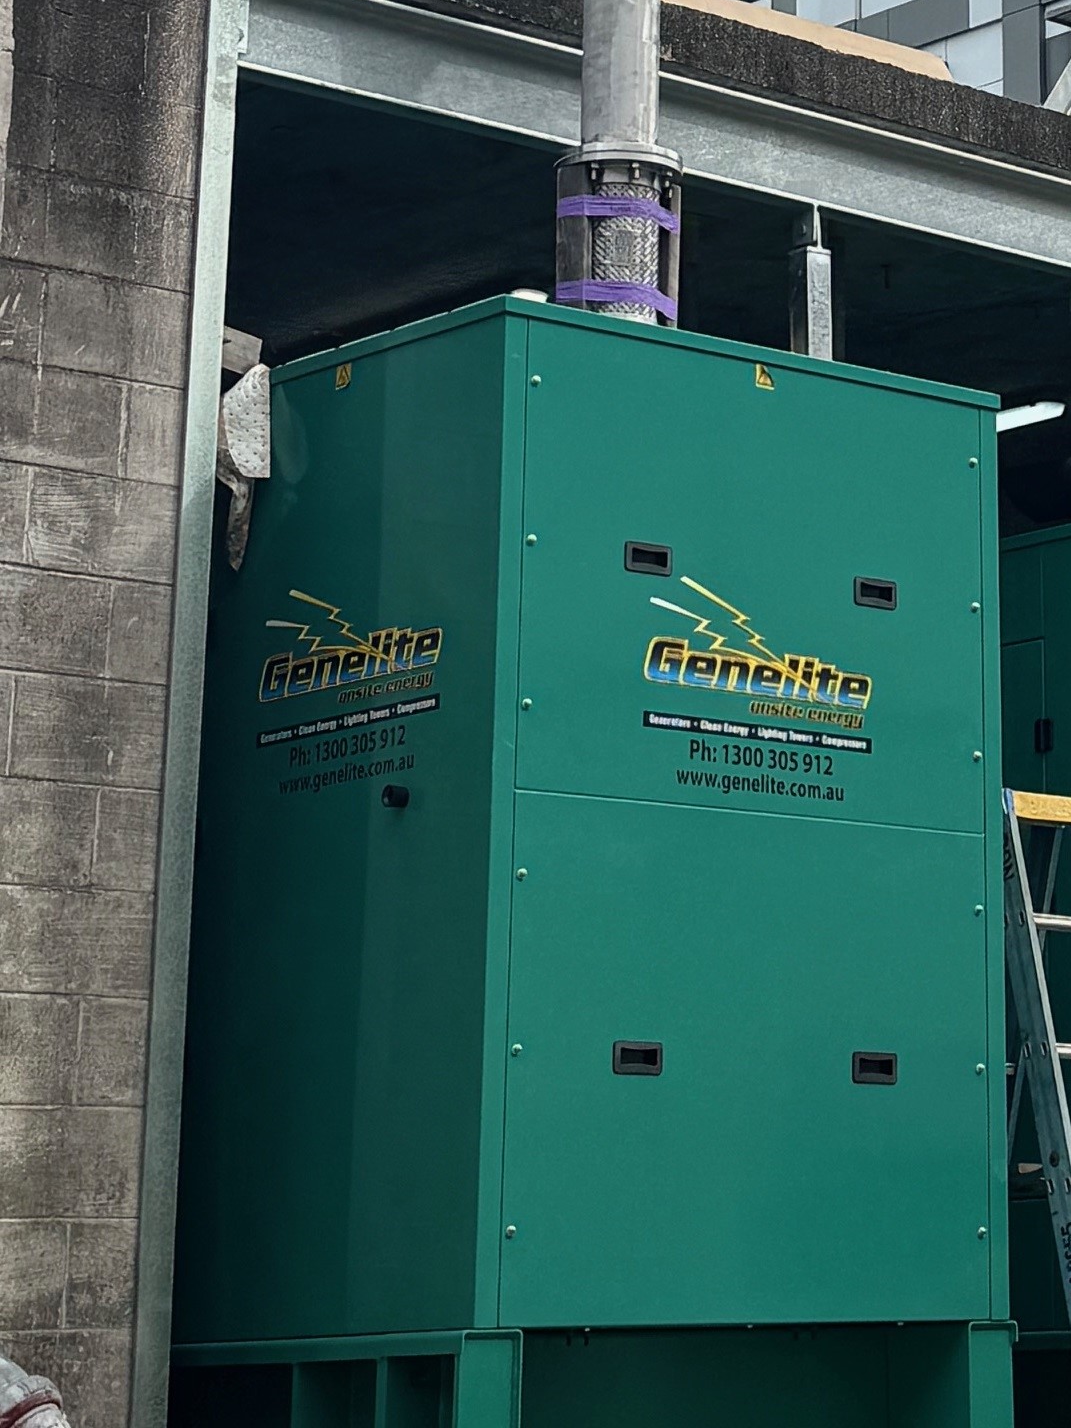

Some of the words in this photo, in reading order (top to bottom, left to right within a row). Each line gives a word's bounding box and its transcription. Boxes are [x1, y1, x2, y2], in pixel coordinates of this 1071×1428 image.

[259, 627, 442, 702] Genelite
[644, 636, 872, 709] Genelite
[289, 746, 311, 768] Ph:
[315, 737, 347, 762] 1300
[350, 731, 376, 756] 305
[380, 725, 406, 749] 912
[689, 739, 717, 762] Ph:
[722, 744, 764, 768] 1300
[768, 749, 799, 771] 305
[802, 752, 834, 776] 912
[278, 754, 415, 795] www.genelite.com.au
[676, 769, 844, 802] www.genelite.com.au
